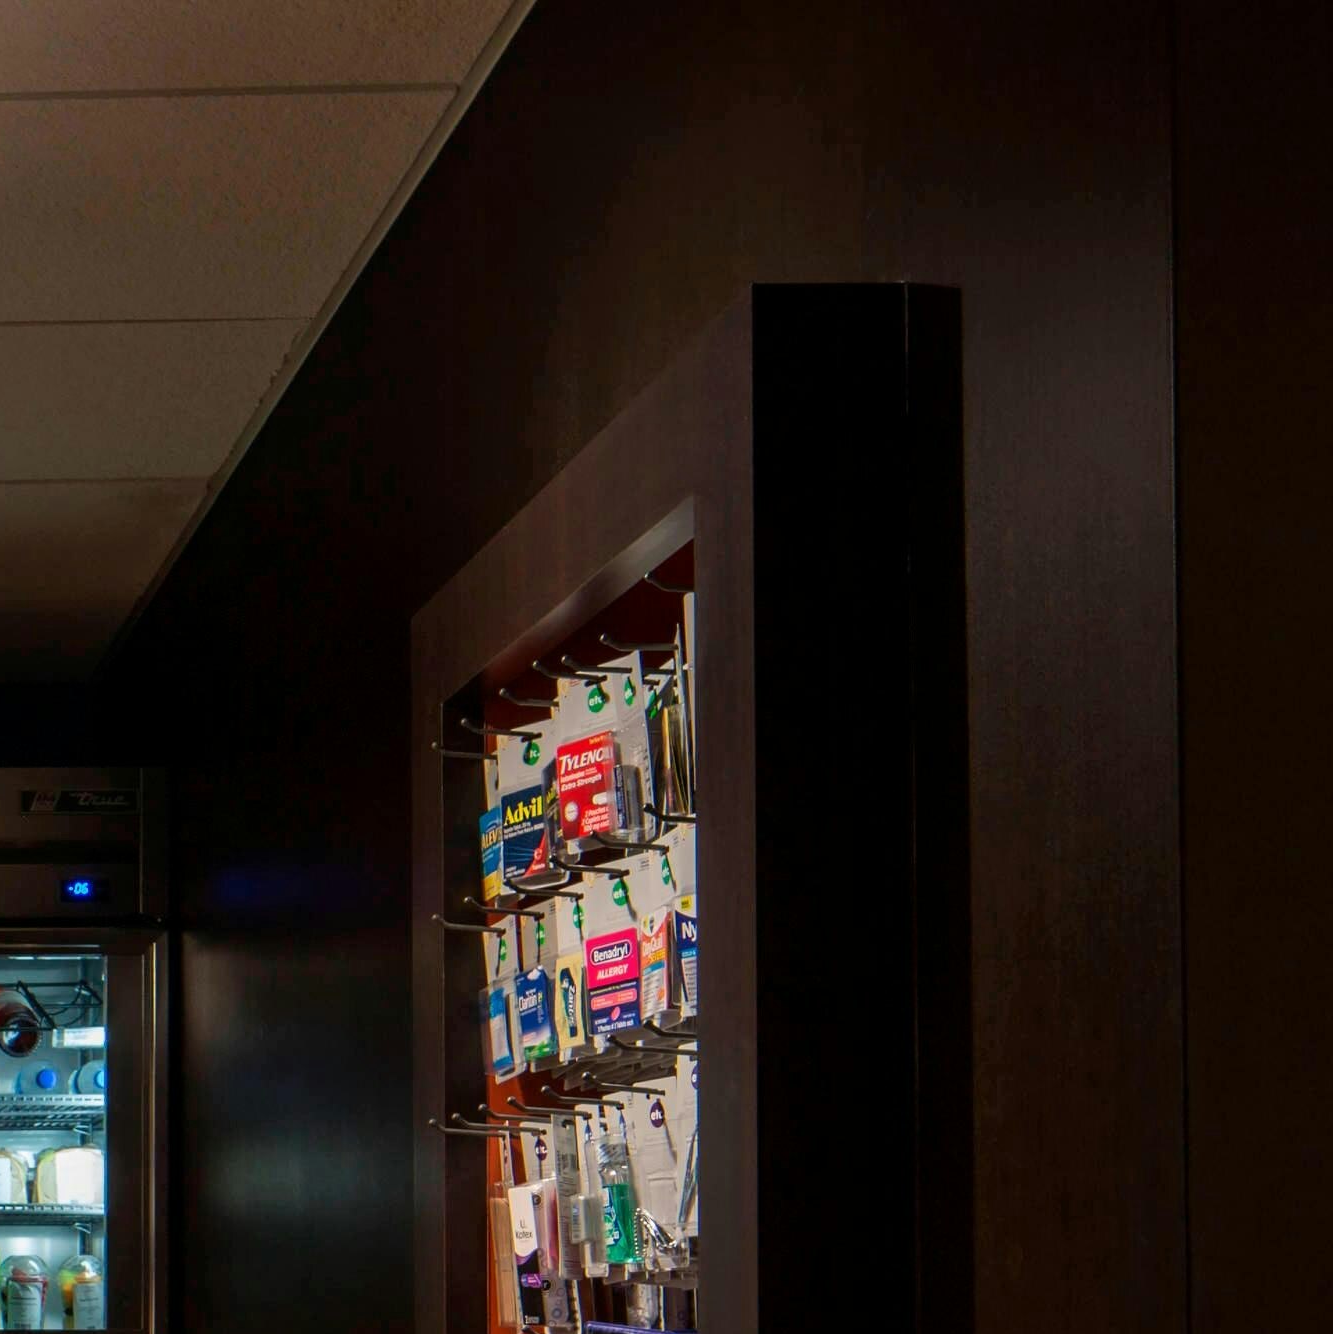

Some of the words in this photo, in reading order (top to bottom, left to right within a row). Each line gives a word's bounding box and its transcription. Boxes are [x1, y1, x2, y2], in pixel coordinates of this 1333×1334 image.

[503, 795, 543, 826] Advil
[593, 944, 629, 964] Benadryl
[596, 964, 629, 980] ALLERGY
